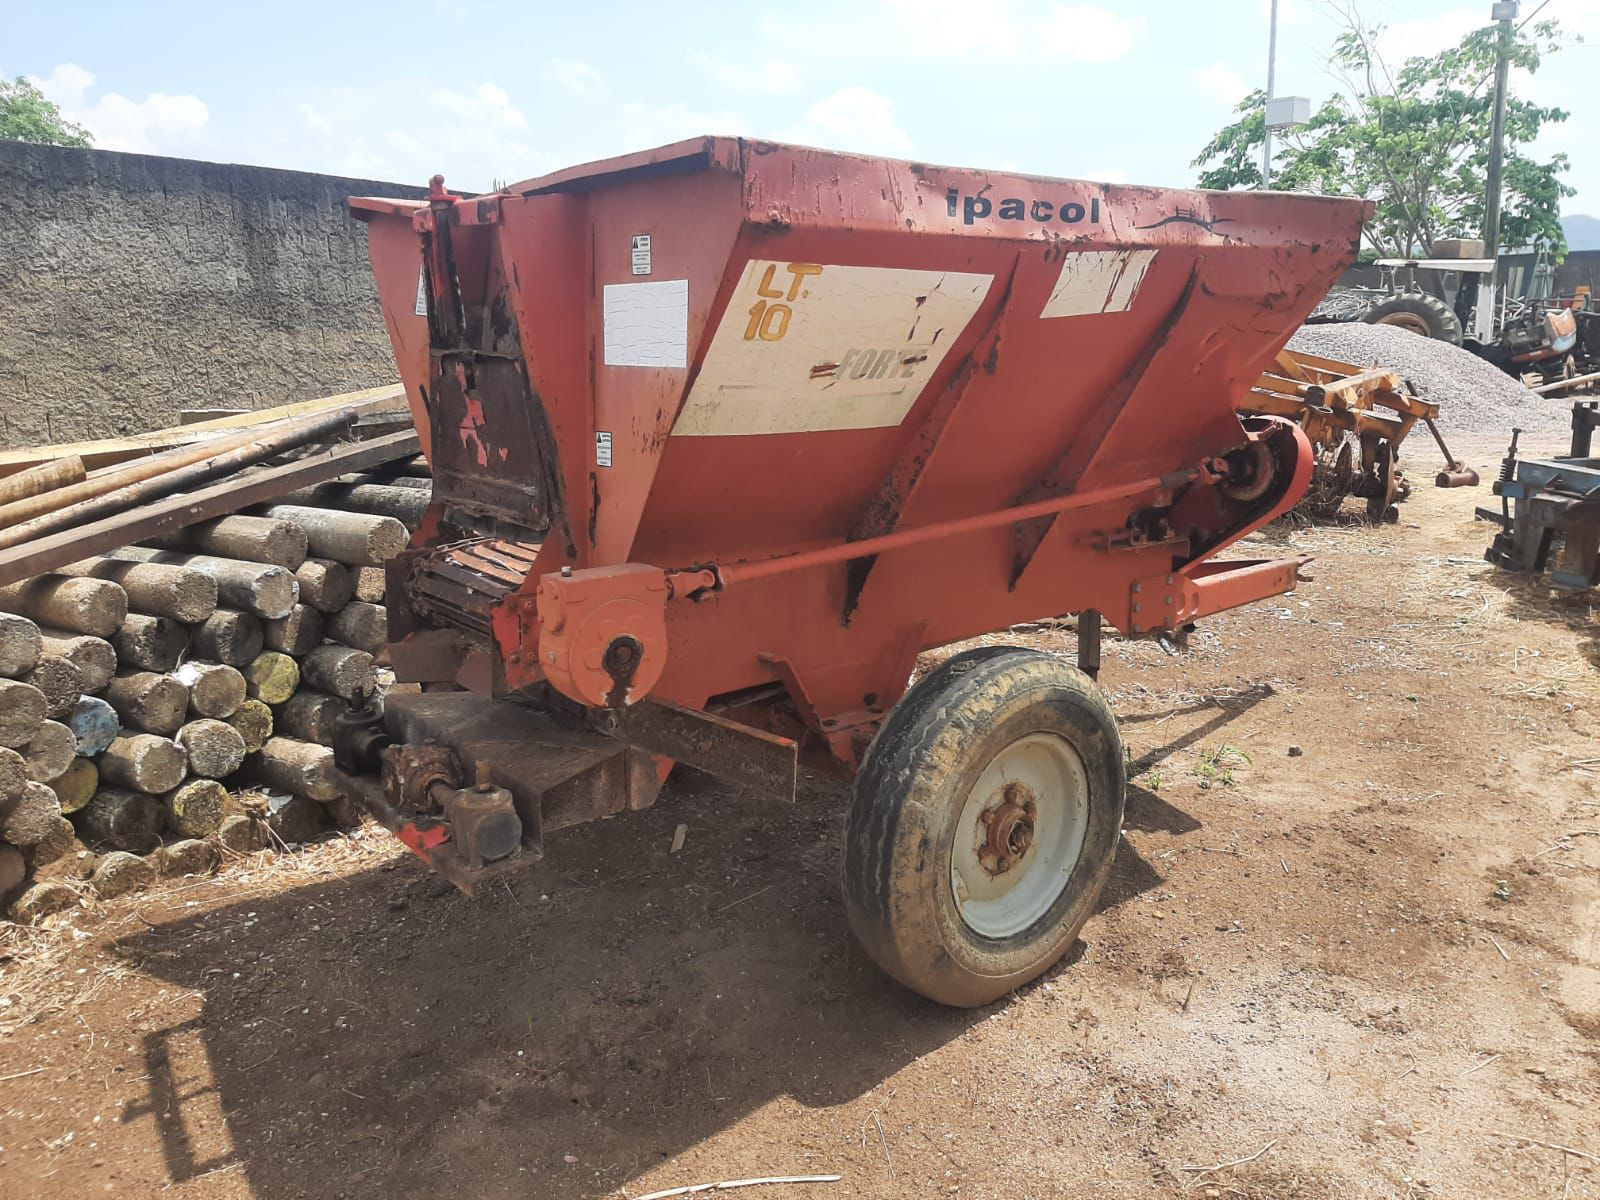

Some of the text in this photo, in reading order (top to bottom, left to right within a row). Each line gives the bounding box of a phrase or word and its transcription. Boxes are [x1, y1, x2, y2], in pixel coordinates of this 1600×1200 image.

[946, 188, 1100, 225] ipacol
[743, 299, 793, 341] 10
[835, 348, 928, 380] FORTE
